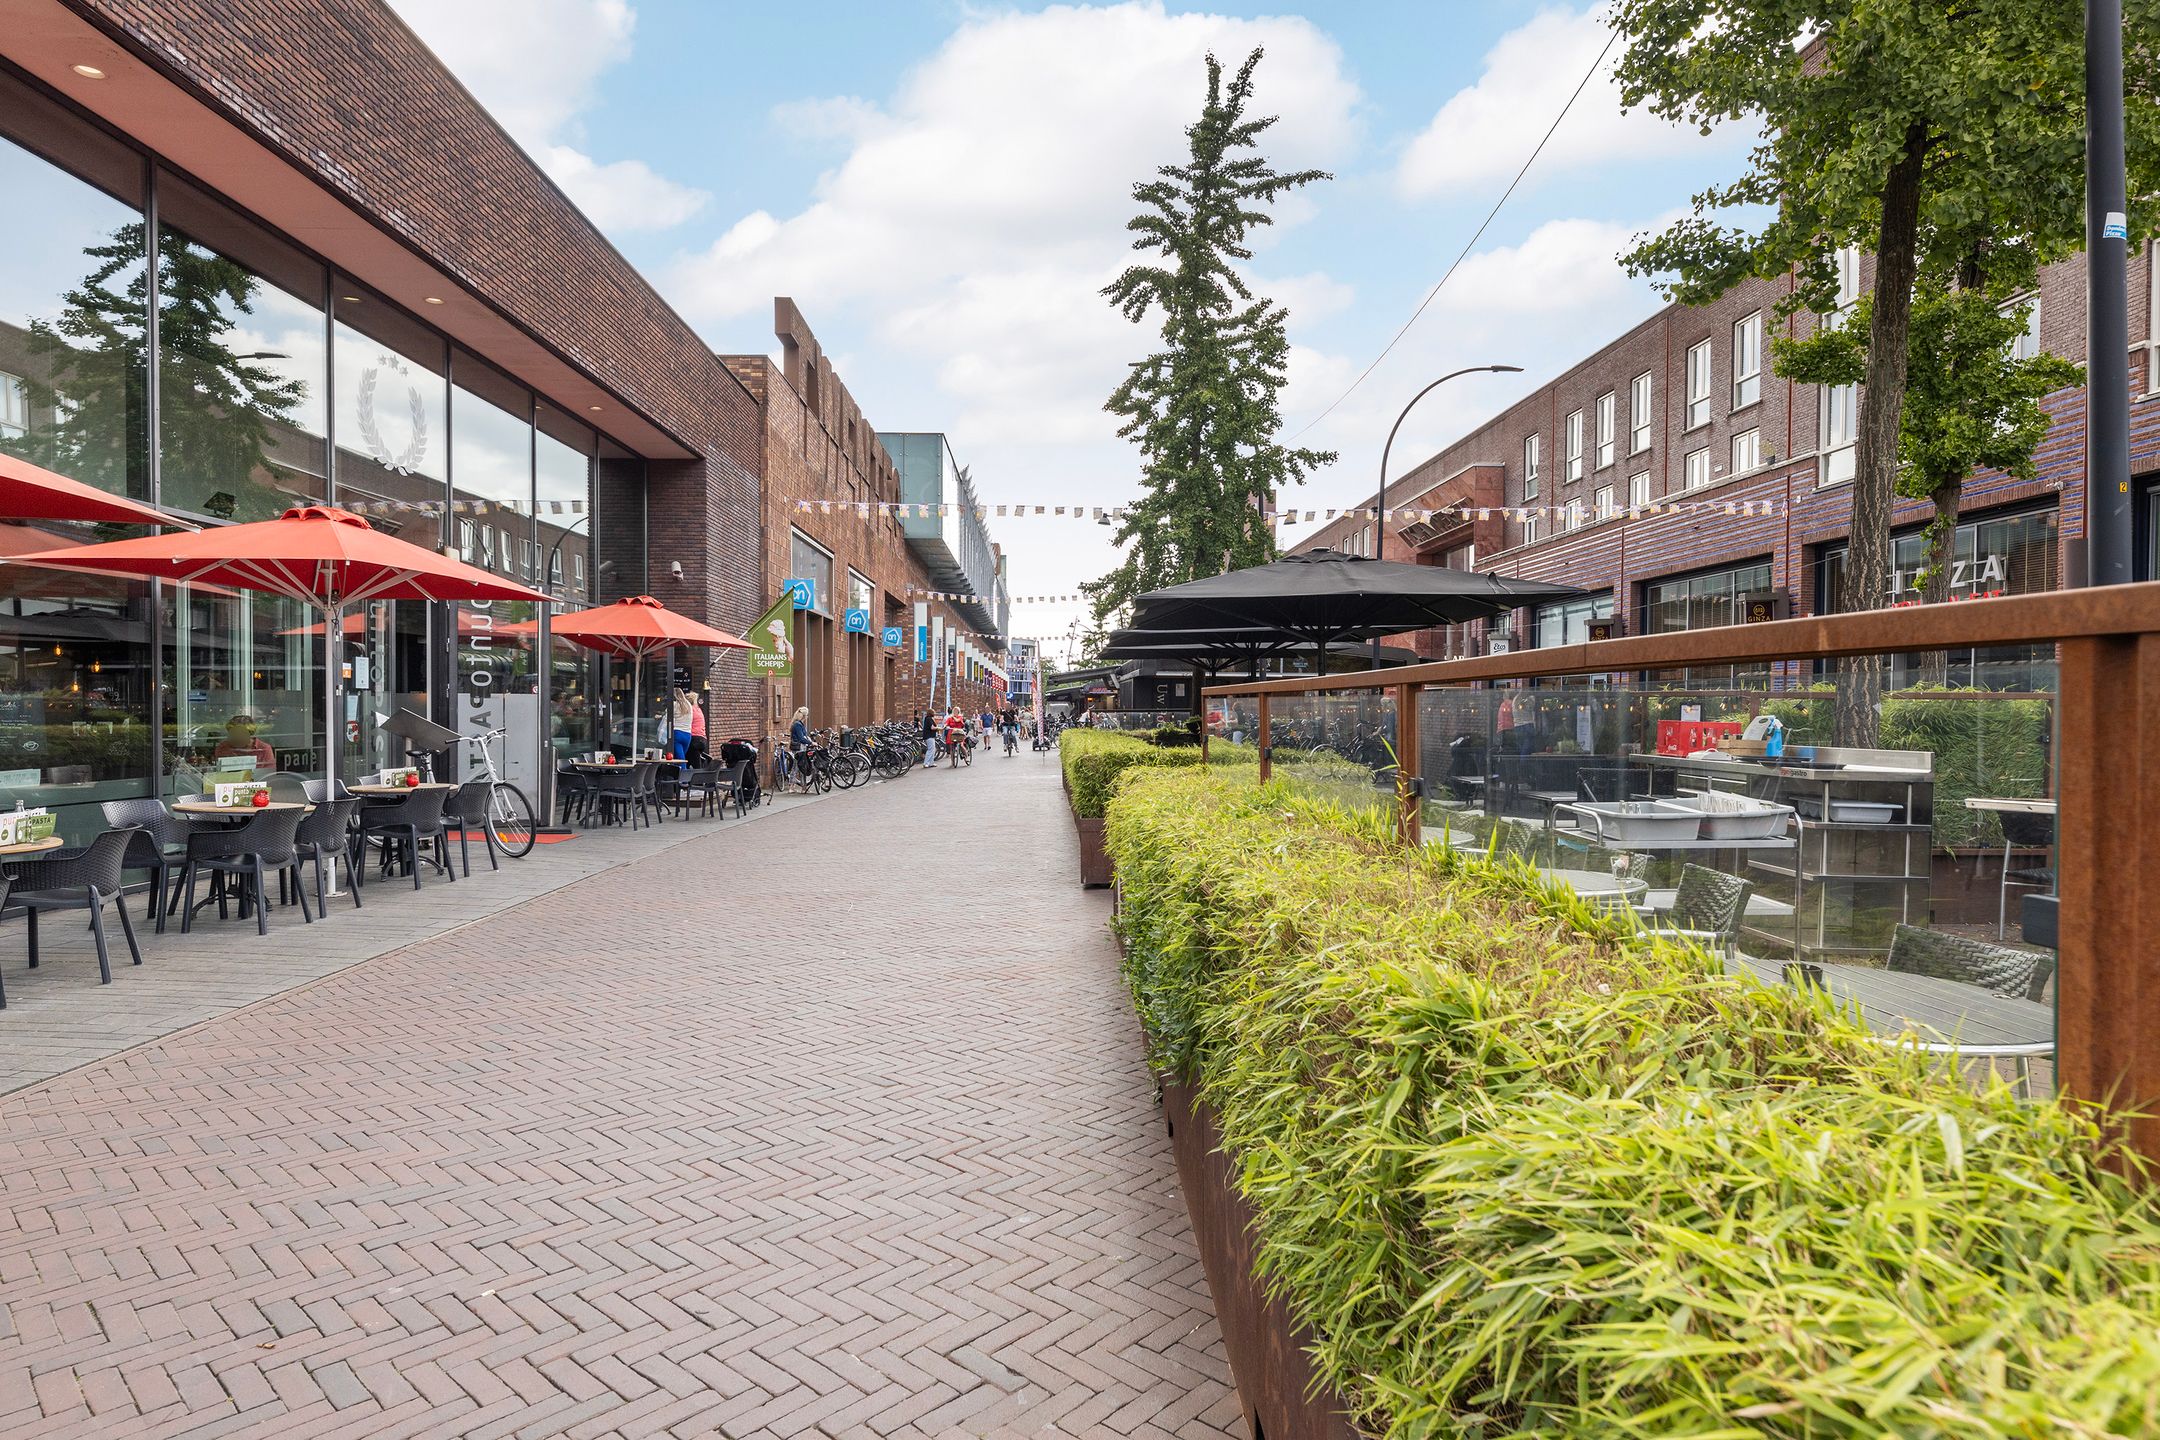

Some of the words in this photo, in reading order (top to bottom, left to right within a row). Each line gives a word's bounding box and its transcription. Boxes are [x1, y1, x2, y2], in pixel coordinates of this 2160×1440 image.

[2121, 482, 2126, 492] 2
[1493, 643, 1506, 652] Etos
[754, 653, 787, 661] ITALIAANS
[757, 660, 785, 669] SCHEPIJS
[1156, 684, 1168, 705] Uw
[284, 752, 317, 772] pane
